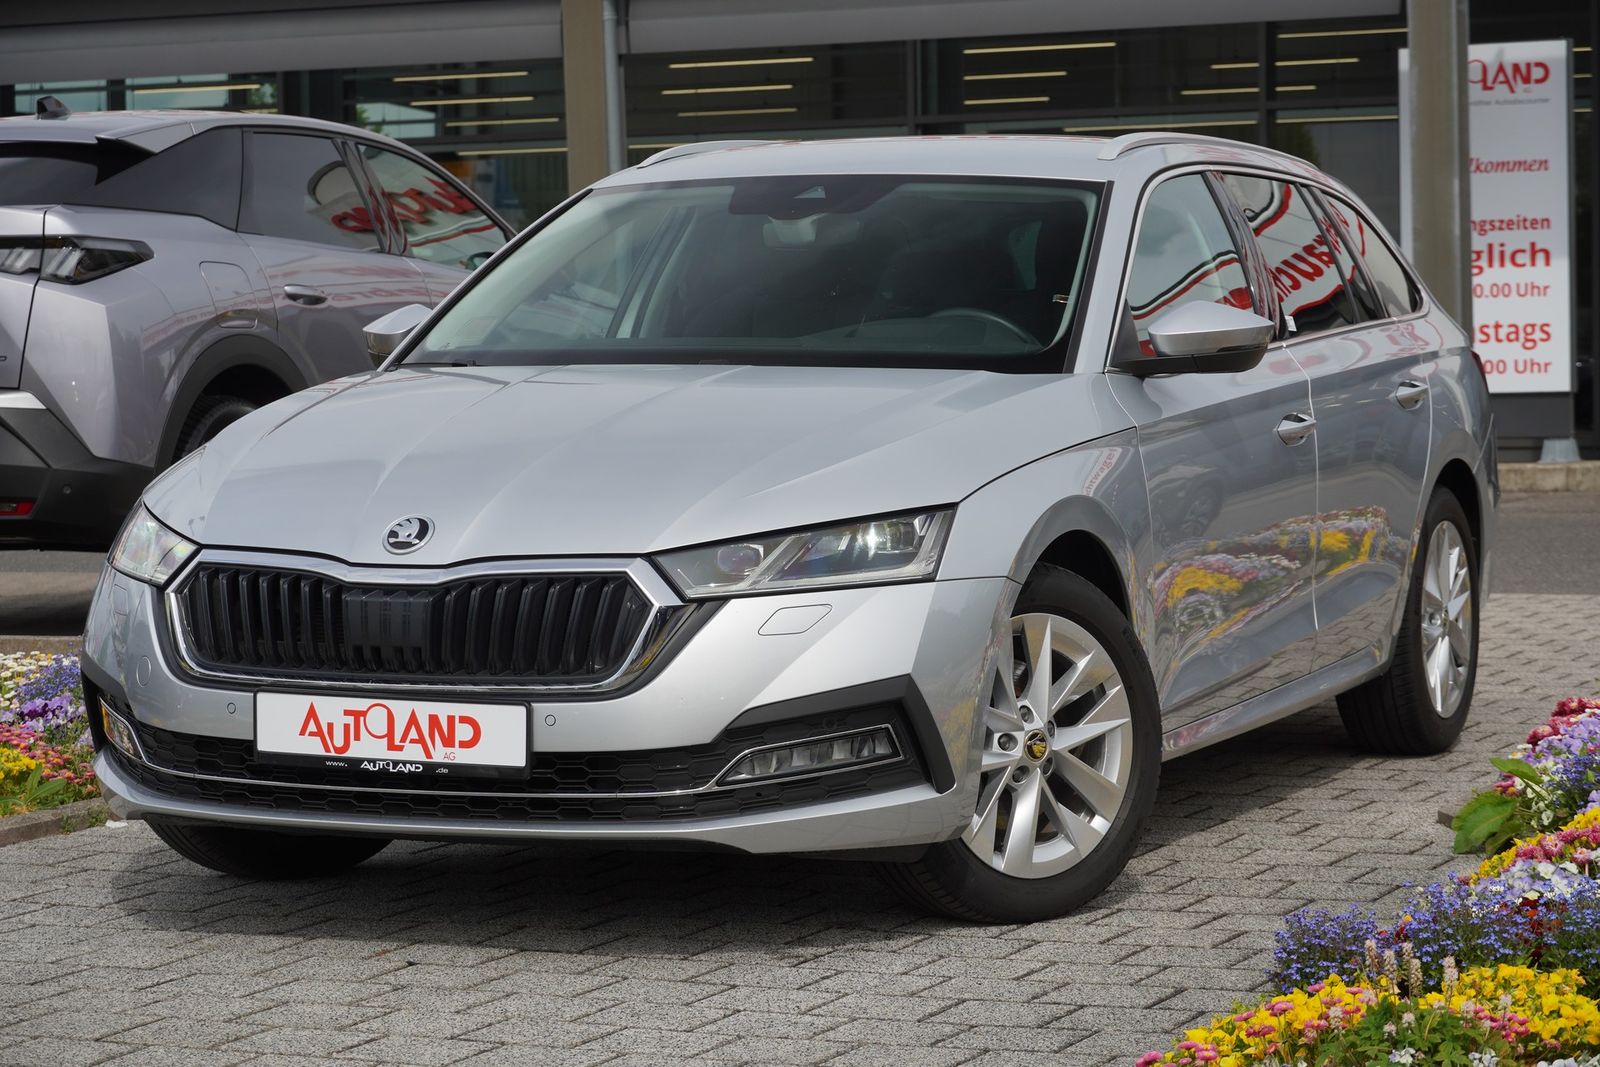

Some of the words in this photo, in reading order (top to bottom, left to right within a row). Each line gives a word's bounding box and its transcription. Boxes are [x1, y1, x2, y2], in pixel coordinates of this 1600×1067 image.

[1472, 241, 1551, 277] glich
[1516, 281, 1551, 297] Uhr
[1472, 320, 1552, 350] stags
[1514, 358, 1552, 374] Uhr
[299, 701, 482, 760] AUTOLAND
[443, 751, 457, 761] AG
[360, 760, 423, 773] AUTOLAND
